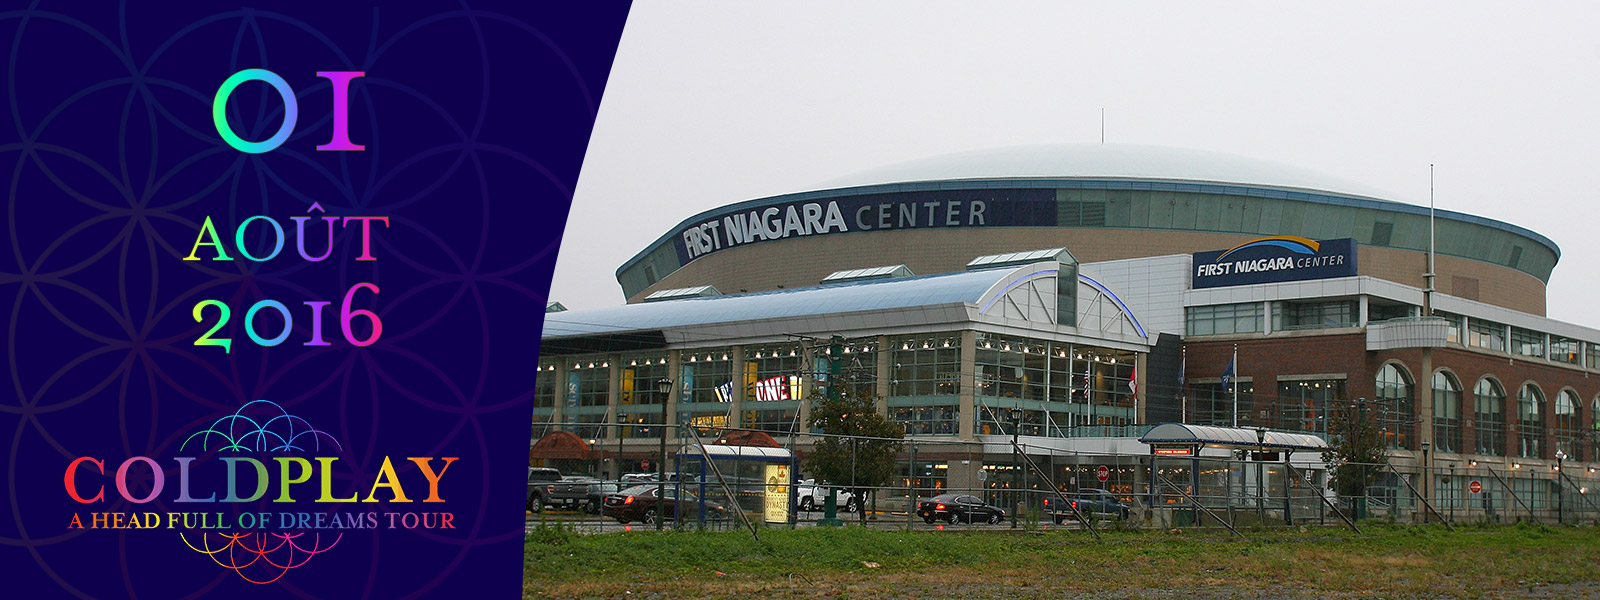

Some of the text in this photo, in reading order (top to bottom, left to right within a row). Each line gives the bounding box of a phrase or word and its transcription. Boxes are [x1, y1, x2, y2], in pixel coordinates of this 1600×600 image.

[684, 200, 987, 259] FIRST NIAGARA CENTER
[1197, 254, 1345, 277] FIRST NIAGARA CENTER
[756, 375, 790, 402] ONE
